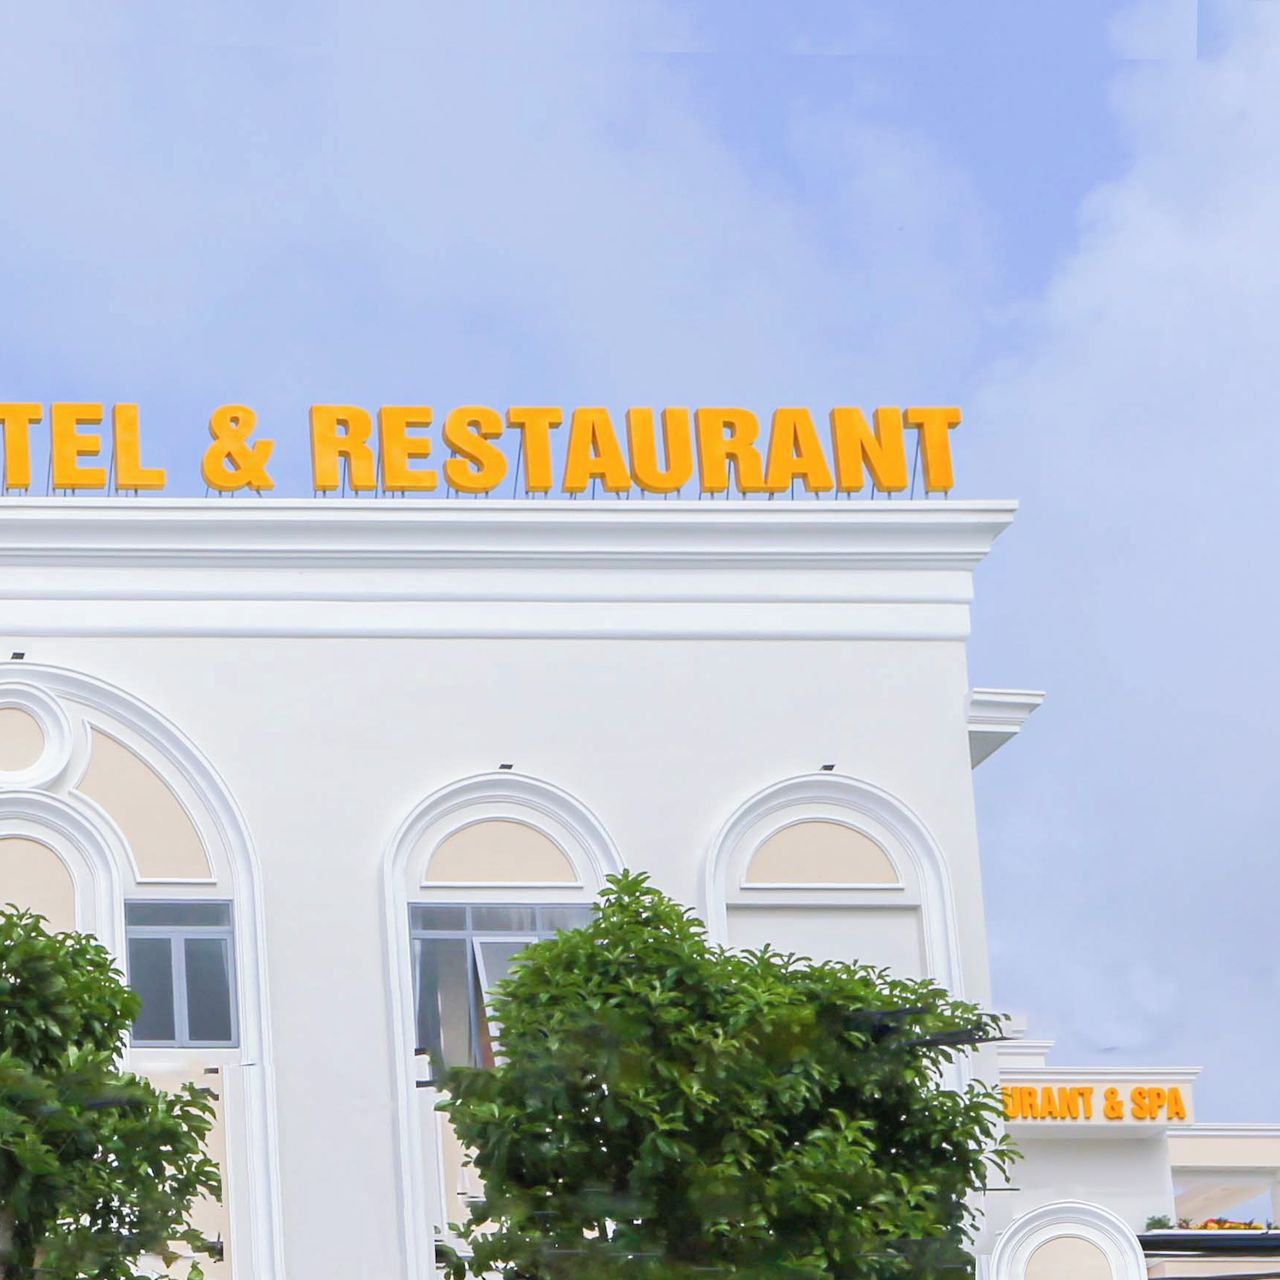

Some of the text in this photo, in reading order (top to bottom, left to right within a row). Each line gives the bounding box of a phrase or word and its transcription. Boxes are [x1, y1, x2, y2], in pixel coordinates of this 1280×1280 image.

[202, 404, 276, 493] &
[309, 405, 961, 494] RESTAURANT
[1104, 1087, 1124, 1120] &
[1131, 1087, 1187, 1120] SPA
